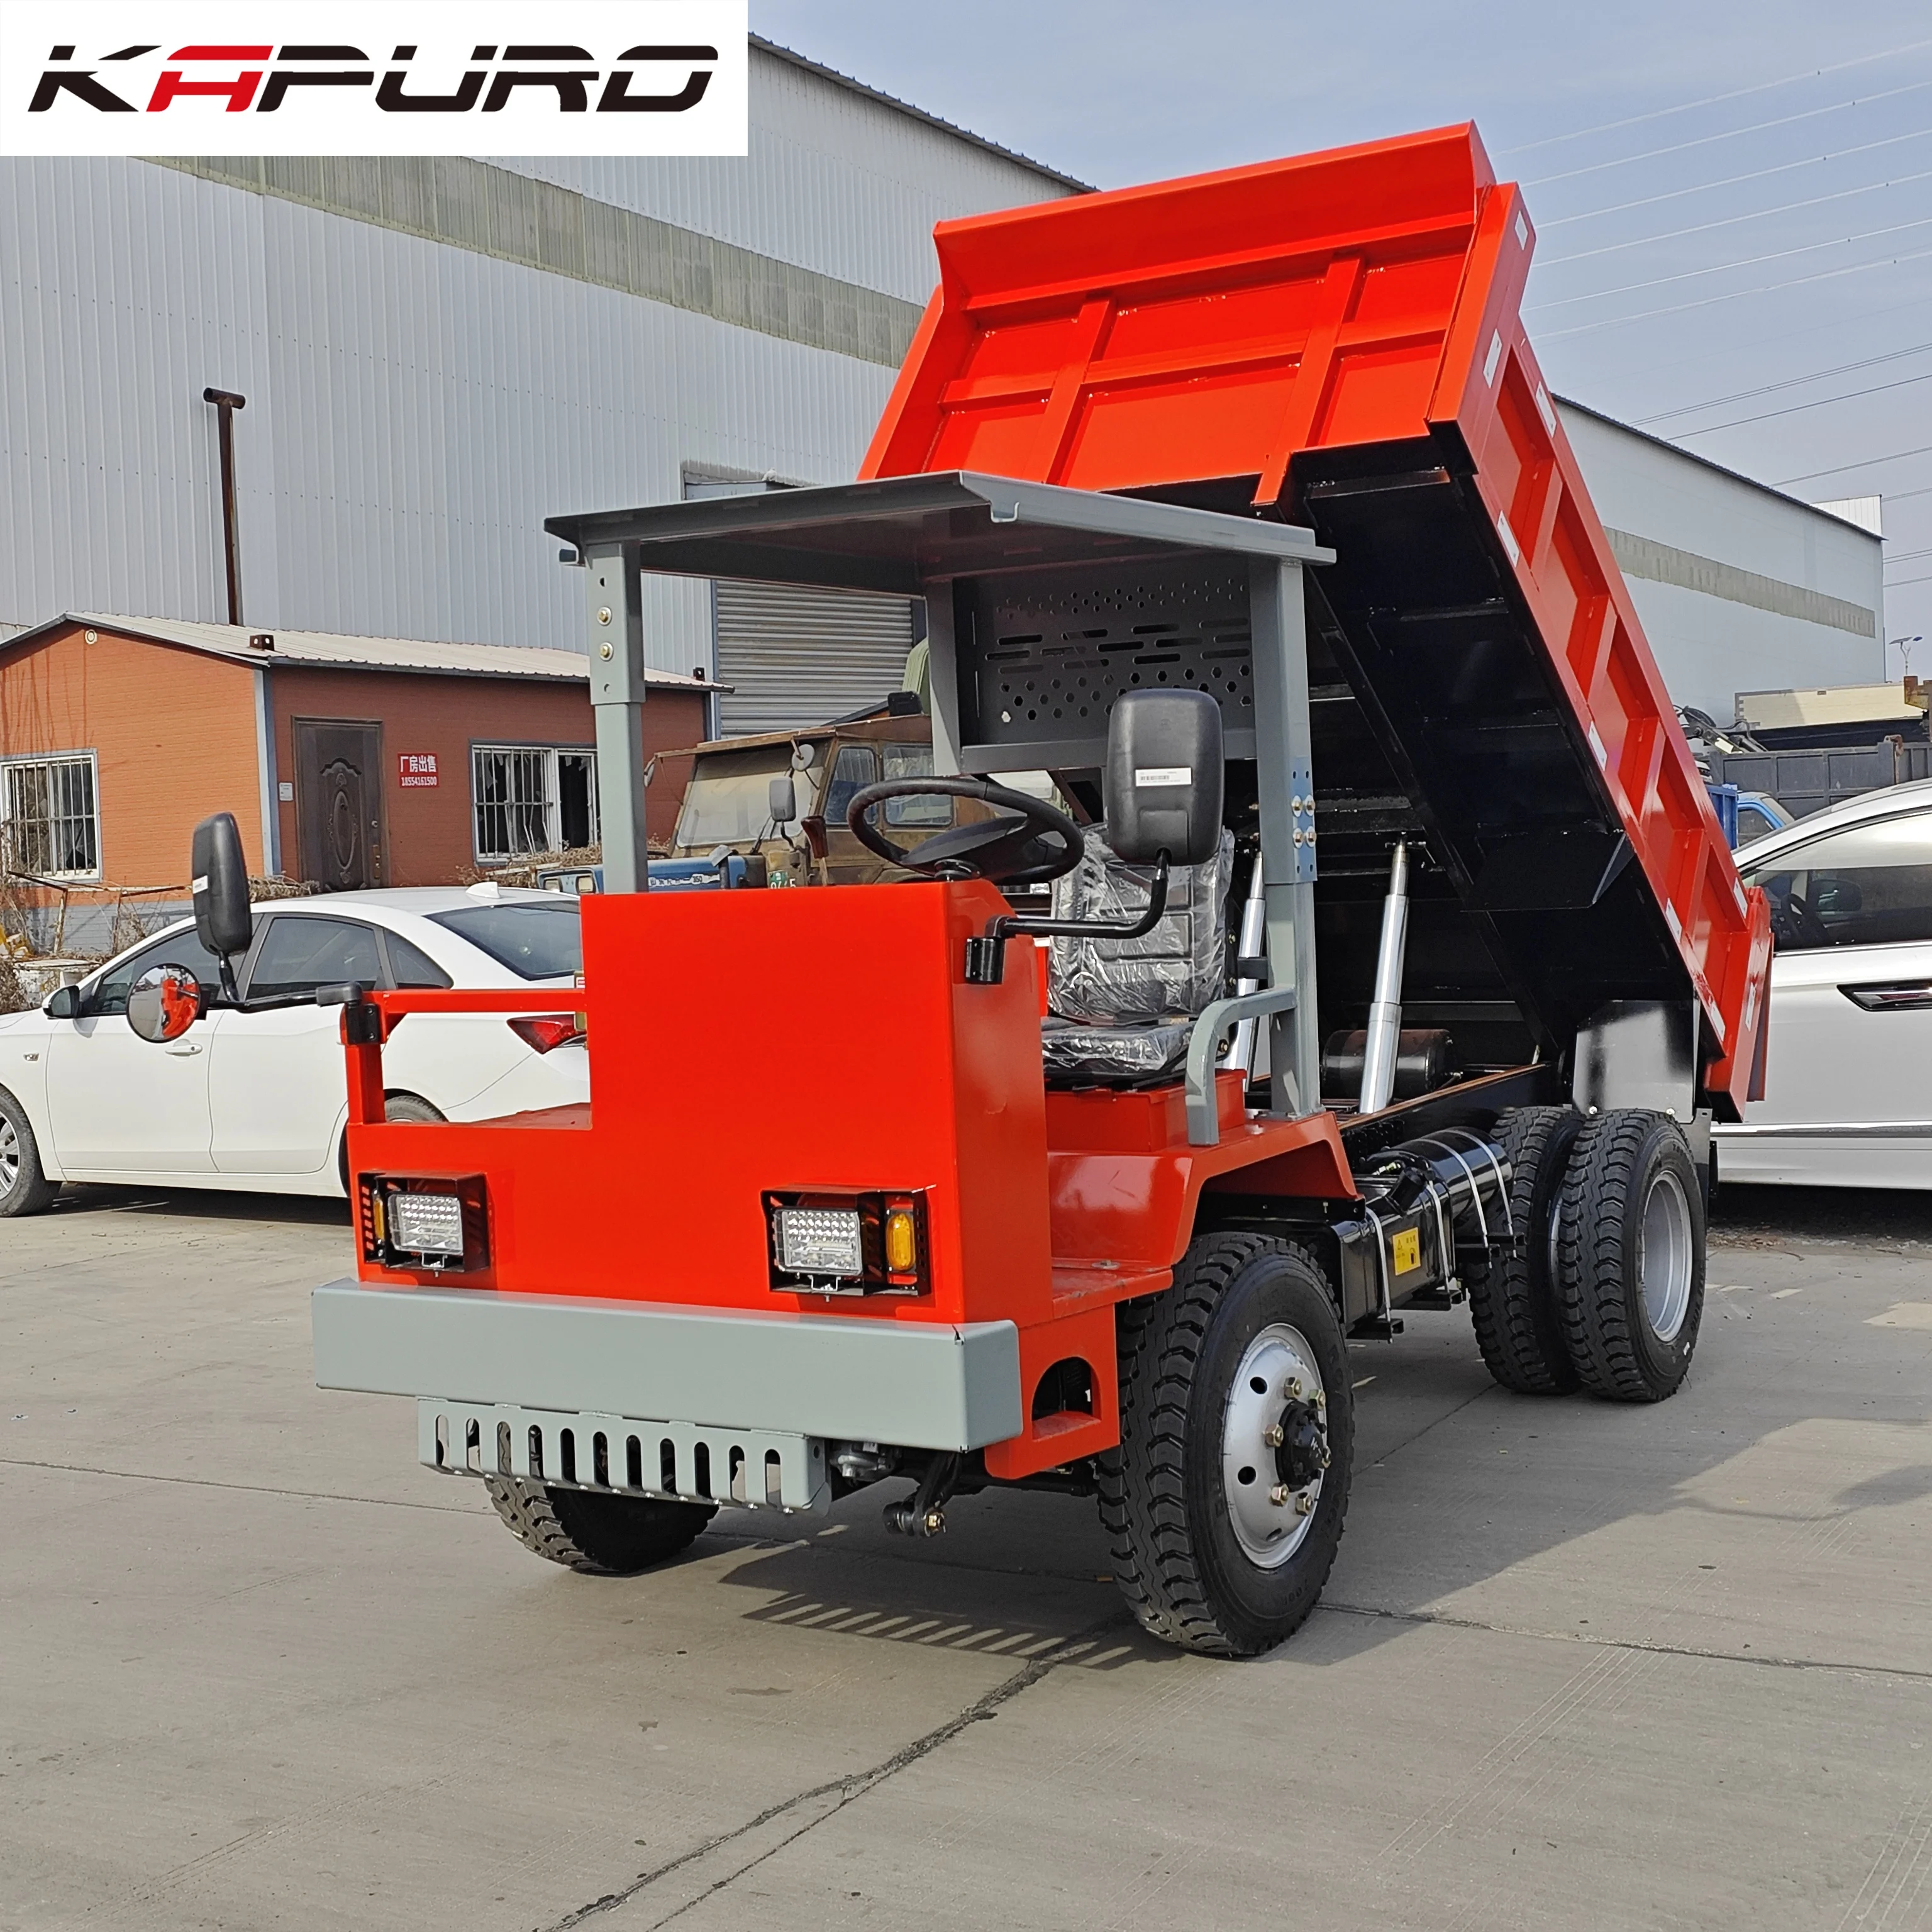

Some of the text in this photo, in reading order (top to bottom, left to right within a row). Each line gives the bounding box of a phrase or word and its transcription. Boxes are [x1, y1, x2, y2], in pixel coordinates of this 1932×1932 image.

[400, 755, 436, 773] 厂房出售
[401, 776, 437, 786] 18554161500
